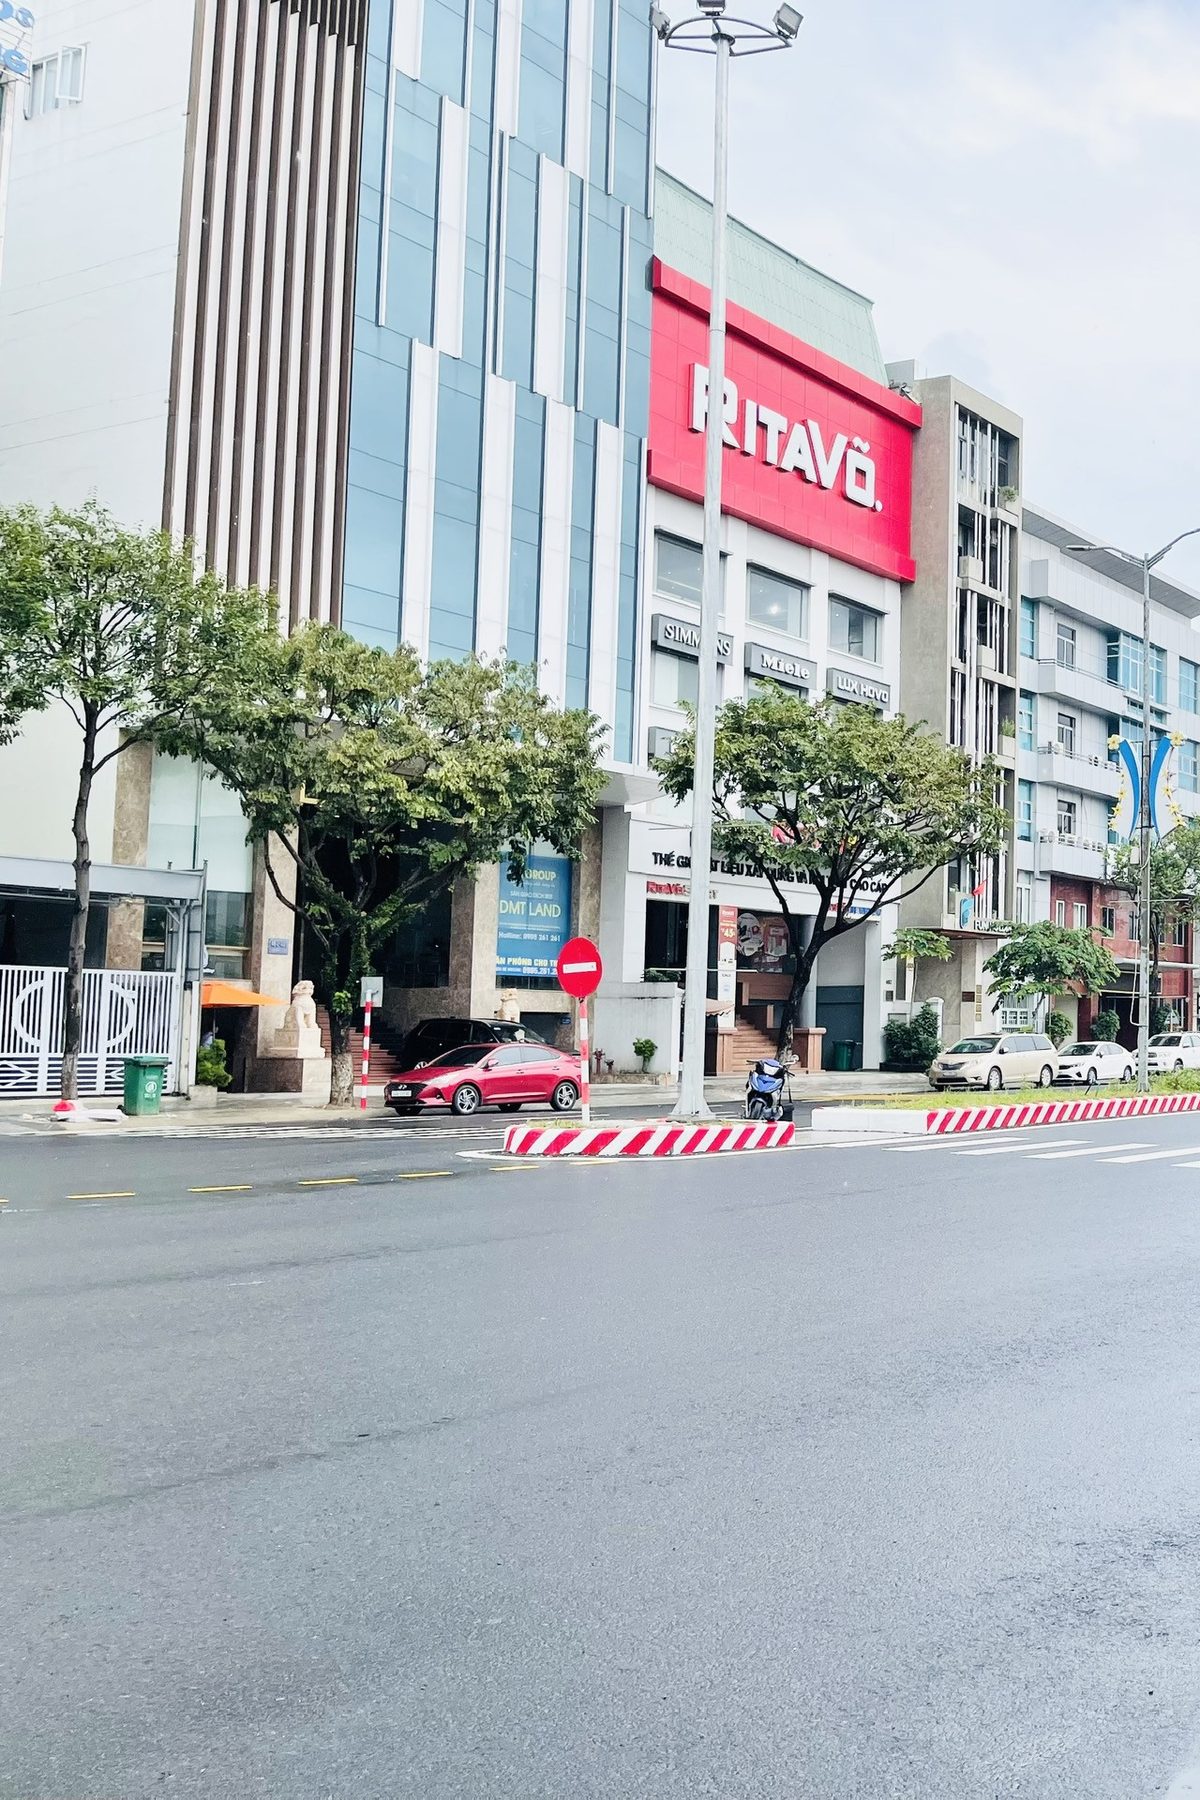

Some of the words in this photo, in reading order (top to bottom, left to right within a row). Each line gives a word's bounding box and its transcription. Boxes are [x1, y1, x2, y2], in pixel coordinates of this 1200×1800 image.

[664, 623, 731, 656] SIMMNS
[761, 653, 810, 680] Miele
[837, 676, 860, 694] LUX
[499, 900, 527, 915] DMT
[528, 902, 561, 918] LAND
